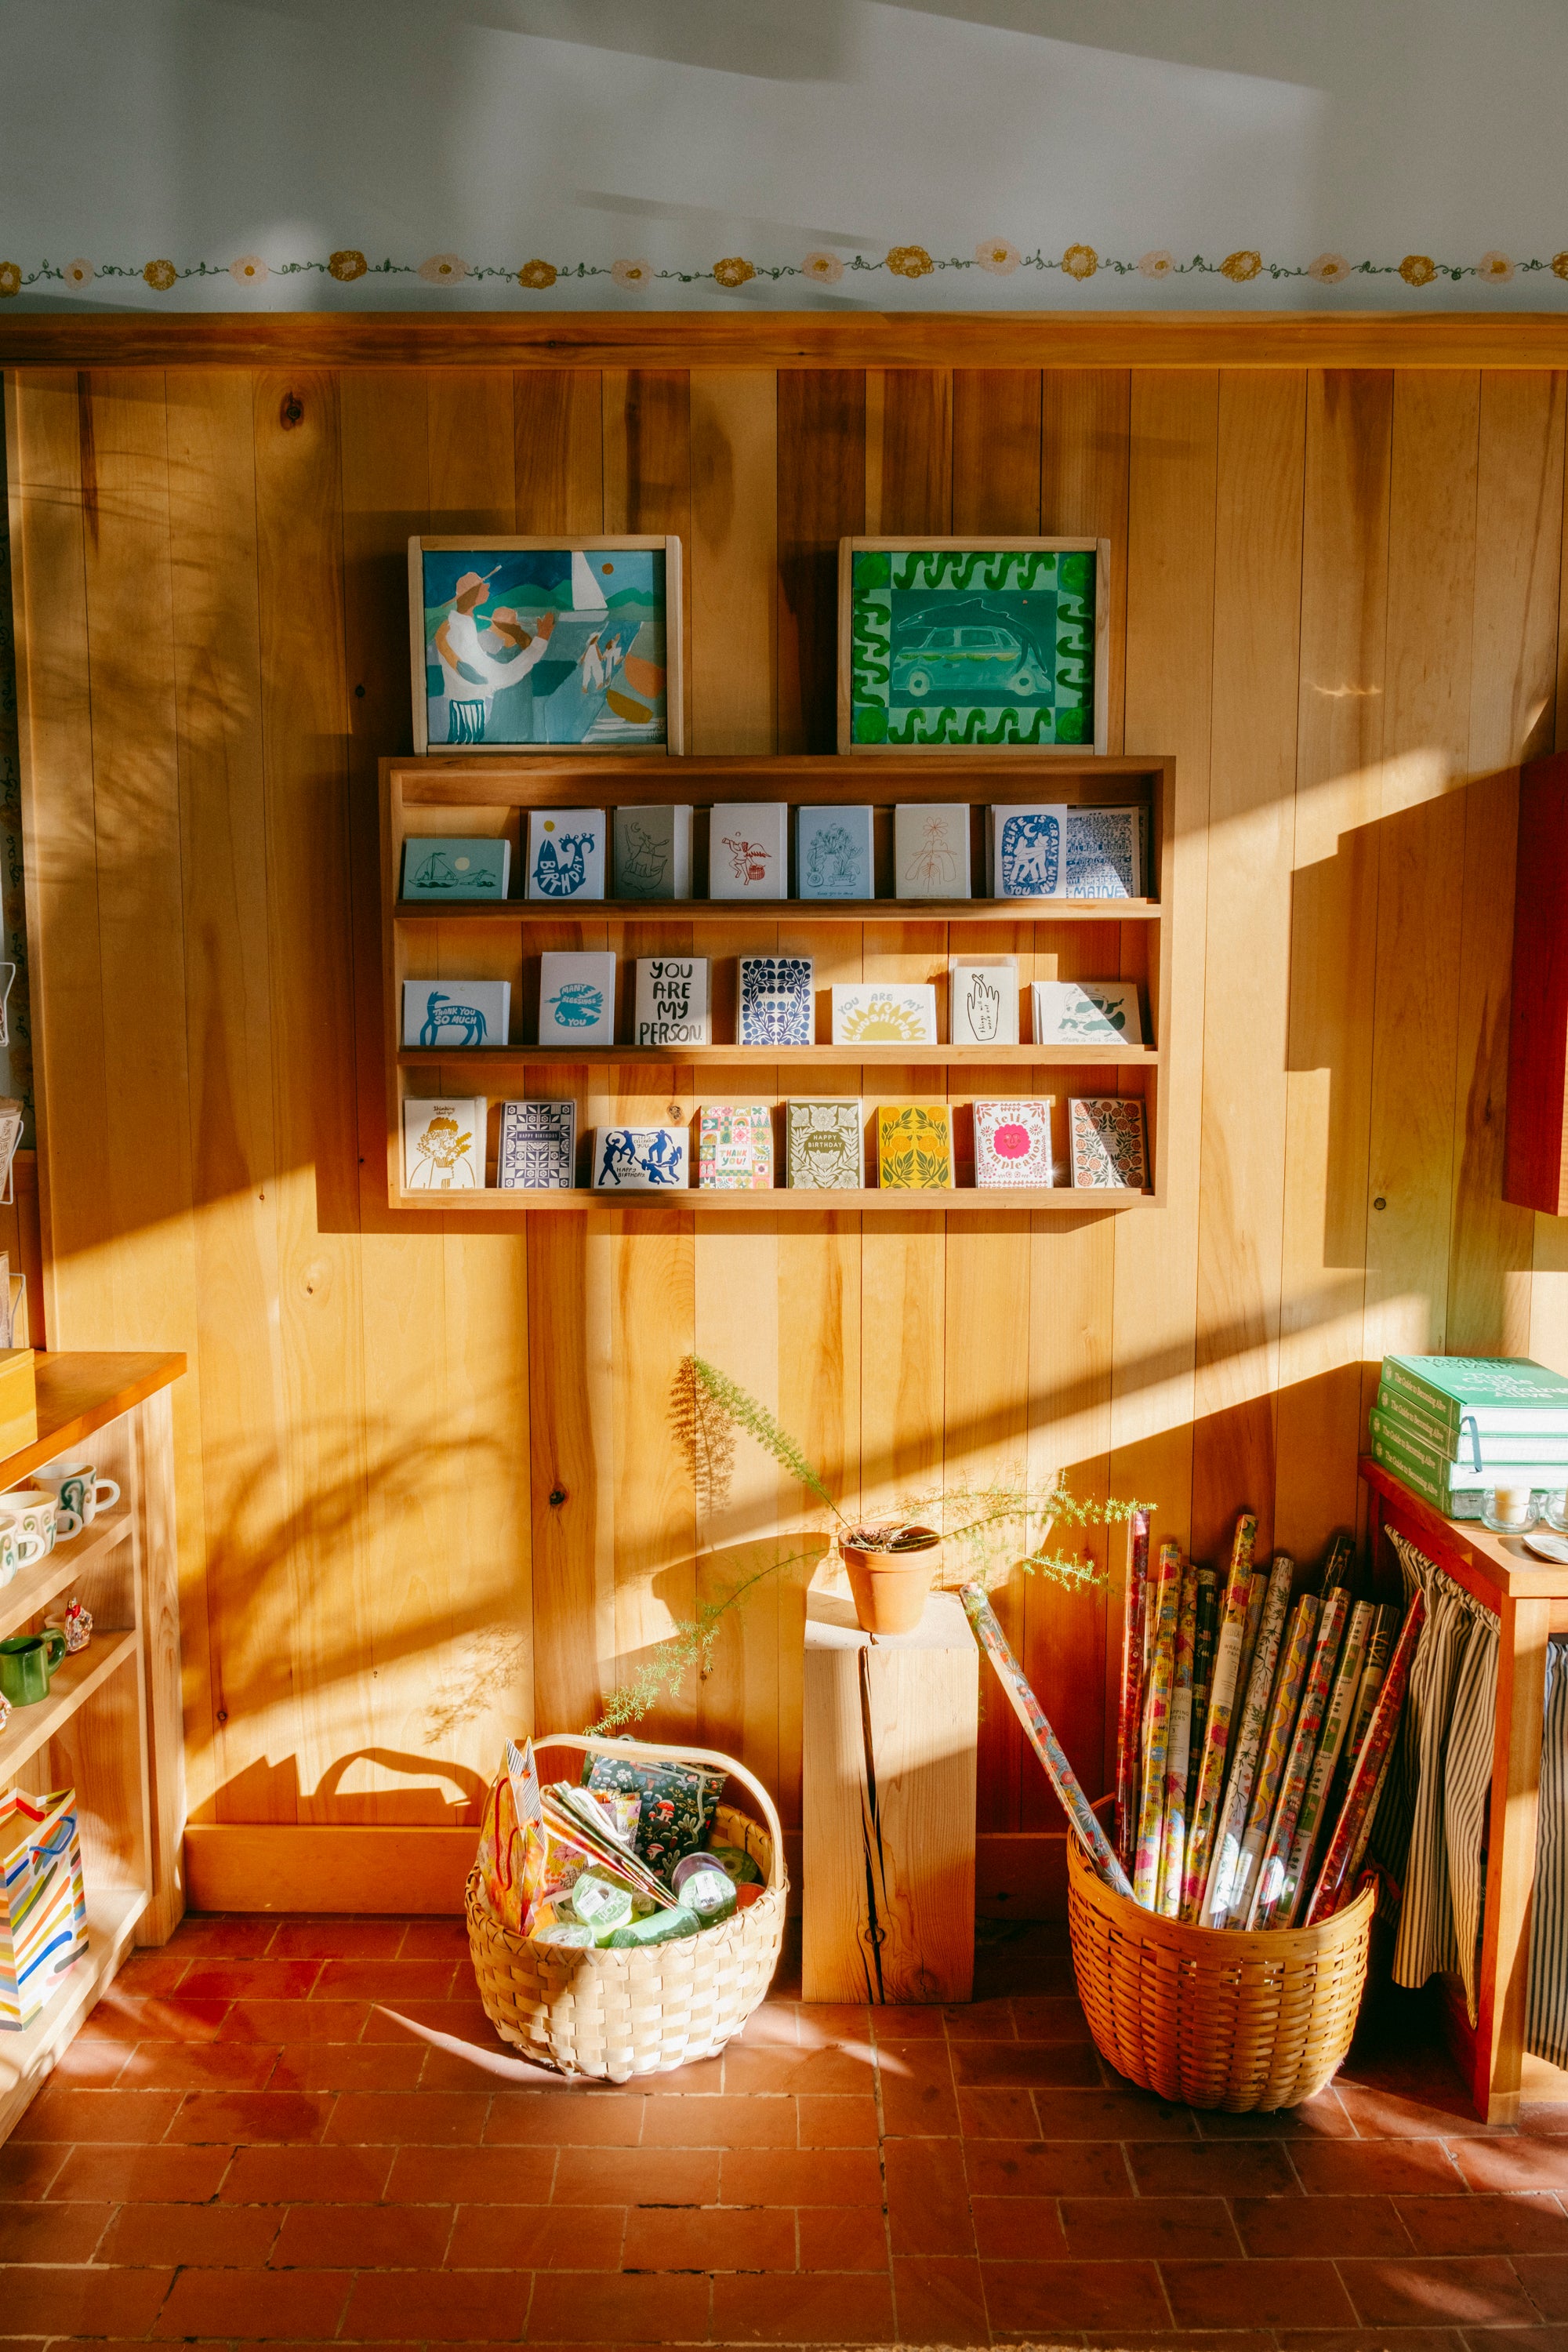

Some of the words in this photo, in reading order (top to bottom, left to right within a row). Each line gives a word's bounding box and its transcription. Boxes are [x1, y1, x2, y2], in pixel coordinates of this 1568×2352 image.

[558, 833, 595, 844] HAPPY
[1006, 817, 1027, 844] LIFE
[1048, 822, 1058, 862] GRAVY
[540, 855, 583, 894] BIRTHDAY
[1040, 866, 1057, 893] WITH
[1011, 885, 1030, 895] YOU
[1074, 885, 1124, 898] MAINE
[649, 961, 692, 978] YOU
[562, 984, 587, 994] MANY
[653, 981, 691, 999] ARE
[433, 1007, 458, 1016] THANK
[459, 1007, 476, 1016] YOU
[657, 1000, 688, 1020] MY
[837, 996, 859, 1015] YOU
[870, 993, 893, 1002] ARE
[903, 999, 924, 1011] MY
[434, 1015, 450, 1025] SO
[556, 1011, 565, 1022] TO
[568, 1018, 586, 1026] YOU
[853, 1013, 912, 1041] SUNSHINE
[978, 1015, 987, 1033] things
[640, 1022, 702, 1045] PERSON.
[994, 1112, 1028, 1126] feliz
[721, 1157, 746, 1166] YOU!
[985, 1138, 1040, 1169] cumpleaños
